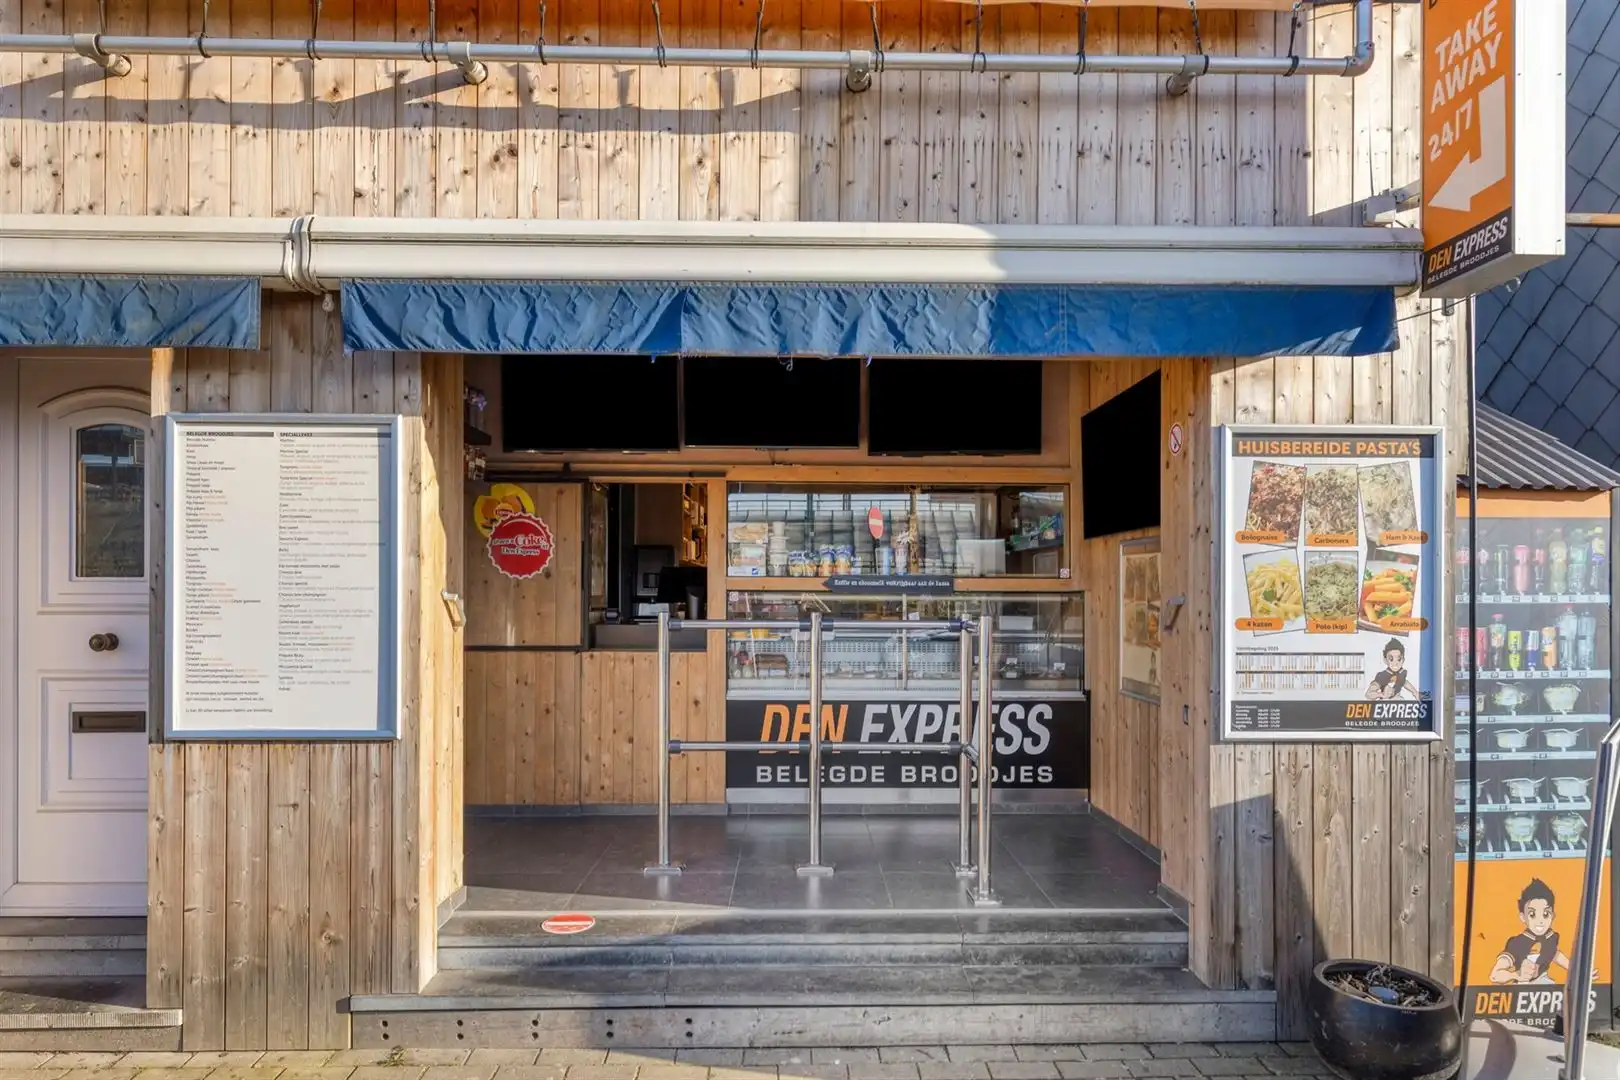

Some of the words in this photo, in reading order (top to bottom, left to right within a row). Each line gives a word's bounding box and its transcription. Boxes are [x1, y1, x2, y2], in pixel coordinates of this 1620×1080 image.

[1435, 0, 1498, 72] TAKE
[1430, 31, 1503, 114] AWAY
[1428, 98, 1473, 163] 24/7
[1427, 244, 1451, 274] DEN
[1453, 216, 1509, 262] EXPRESS
[1427, 264, 1458, 284] BELEGDE
[1459, 244, 1500, 269] BROODJES
[1238, 440, 1351, 455] HUISBEREIDE
[1356, 440, 1422, 456] PASTA'S
[1345, 703, 1372, 718] DEN
[1373, 703, 1428, 719] EXPRESS
[756, 765, 886, 783] BELGDE
[1475, 992, 1512, 1014] DEN
[1515, 991, 1597, 1014] EXPRS
